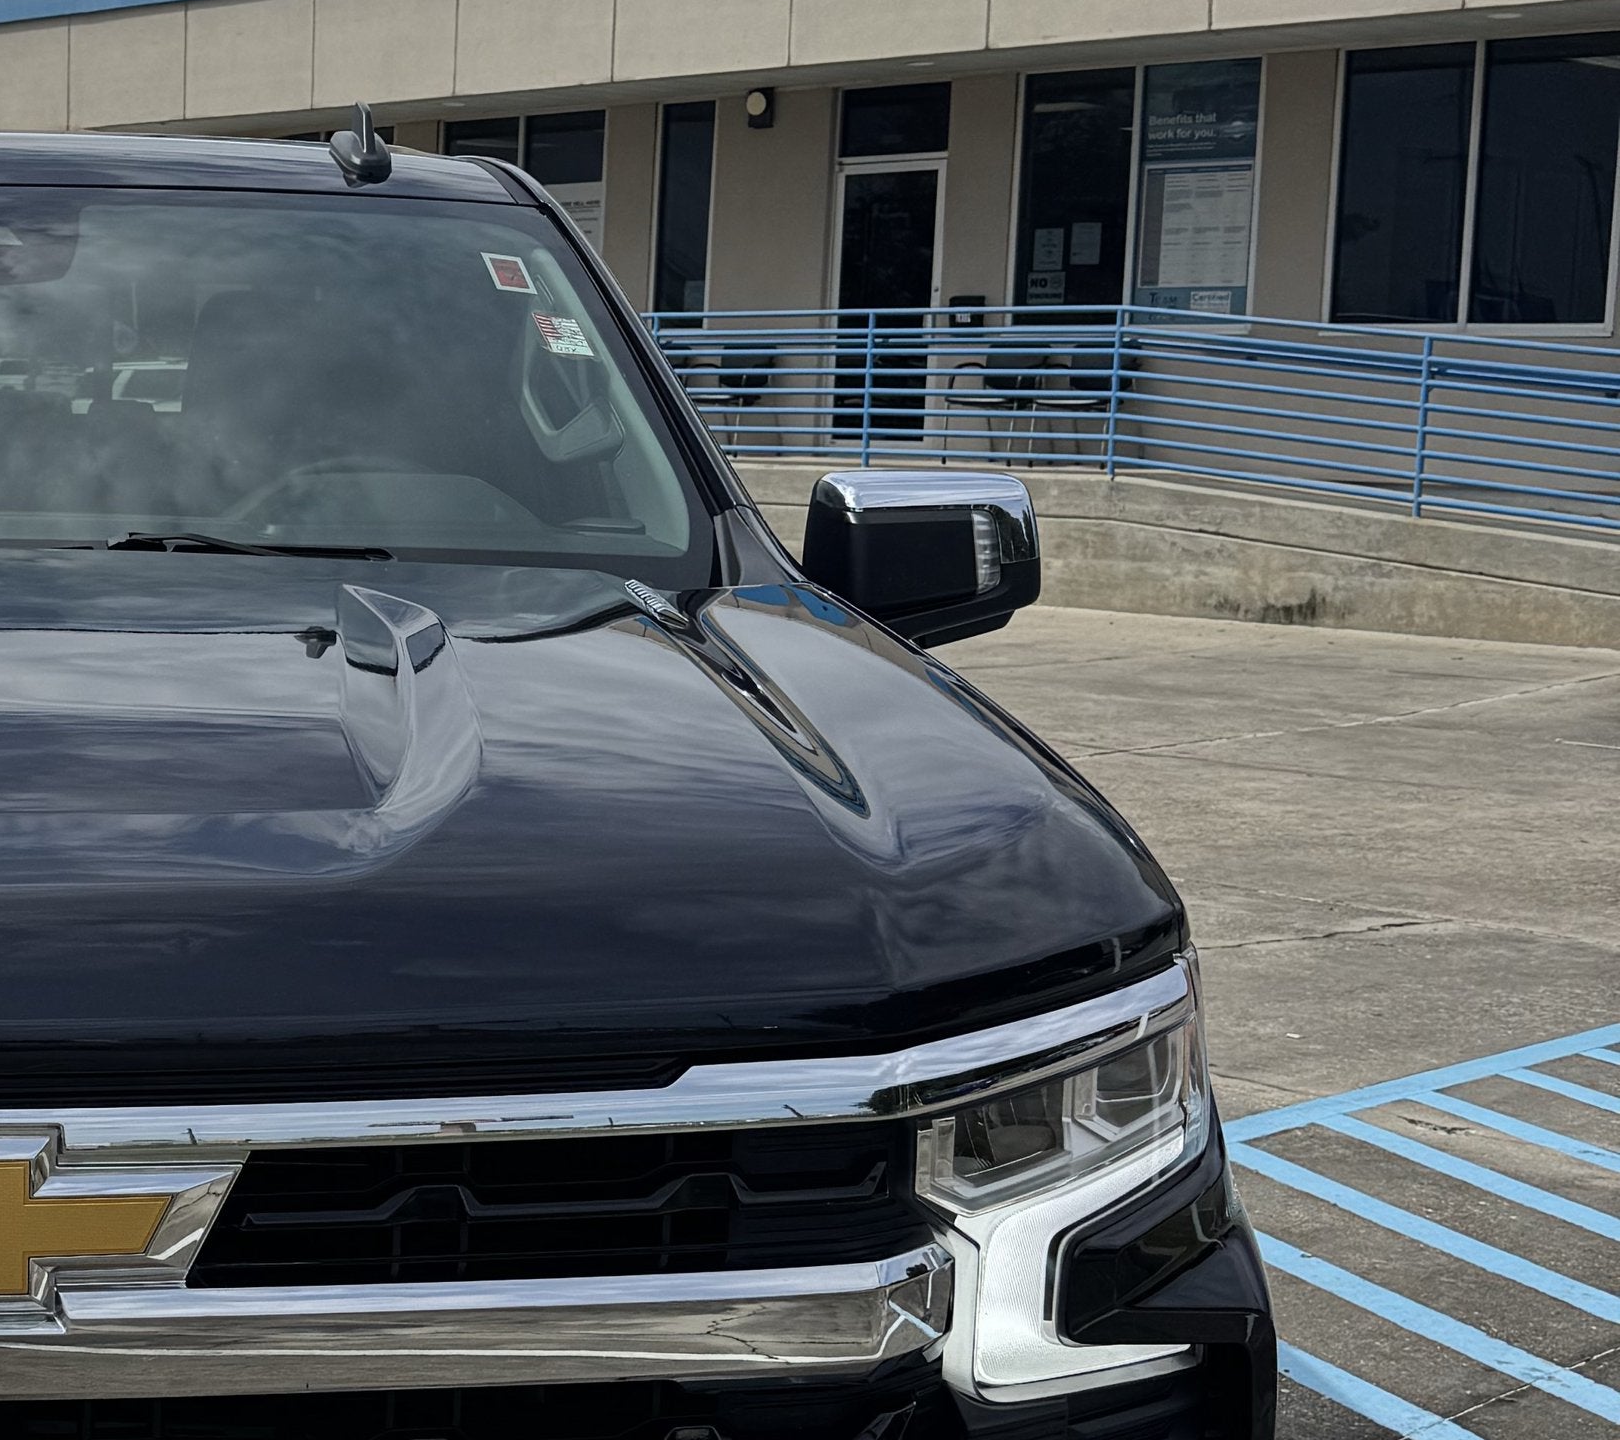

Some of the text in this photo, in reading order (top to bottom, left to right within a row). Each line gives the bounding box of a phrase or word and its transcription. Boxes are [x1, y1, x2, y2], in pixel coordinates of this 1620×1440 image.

[1148, 111, 1217, 127] Benefits that
[1147, 128, 1174, 141] work
[1176, 128, 1192, 139] for
[1029, 277, 1049, 289] NO
